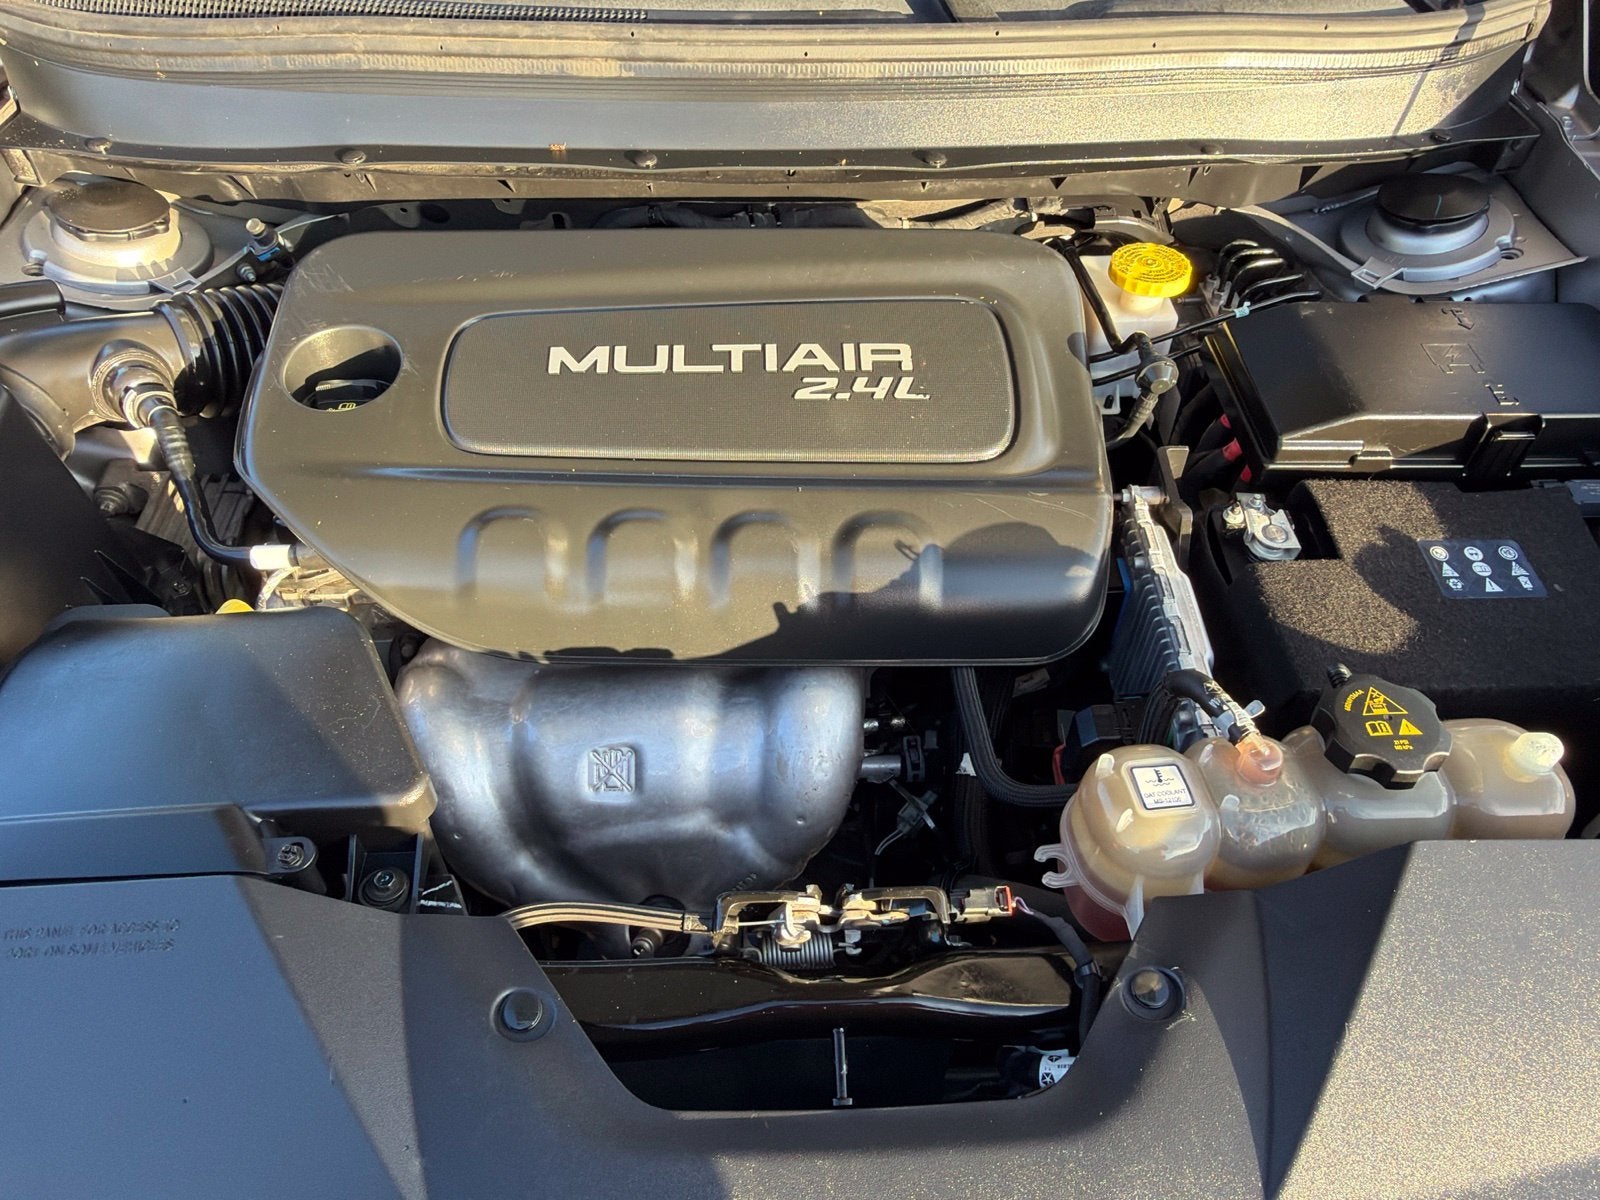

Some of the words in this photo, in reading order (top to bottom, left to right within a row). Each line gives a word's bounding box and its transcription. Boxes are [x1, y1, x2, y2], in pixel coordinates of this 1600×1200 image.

[548, 343, 914, 374] MULTIAIR
[794, 376, 931, 401] 2.4L
[1157, 788, 1186, 797] COOLANT
